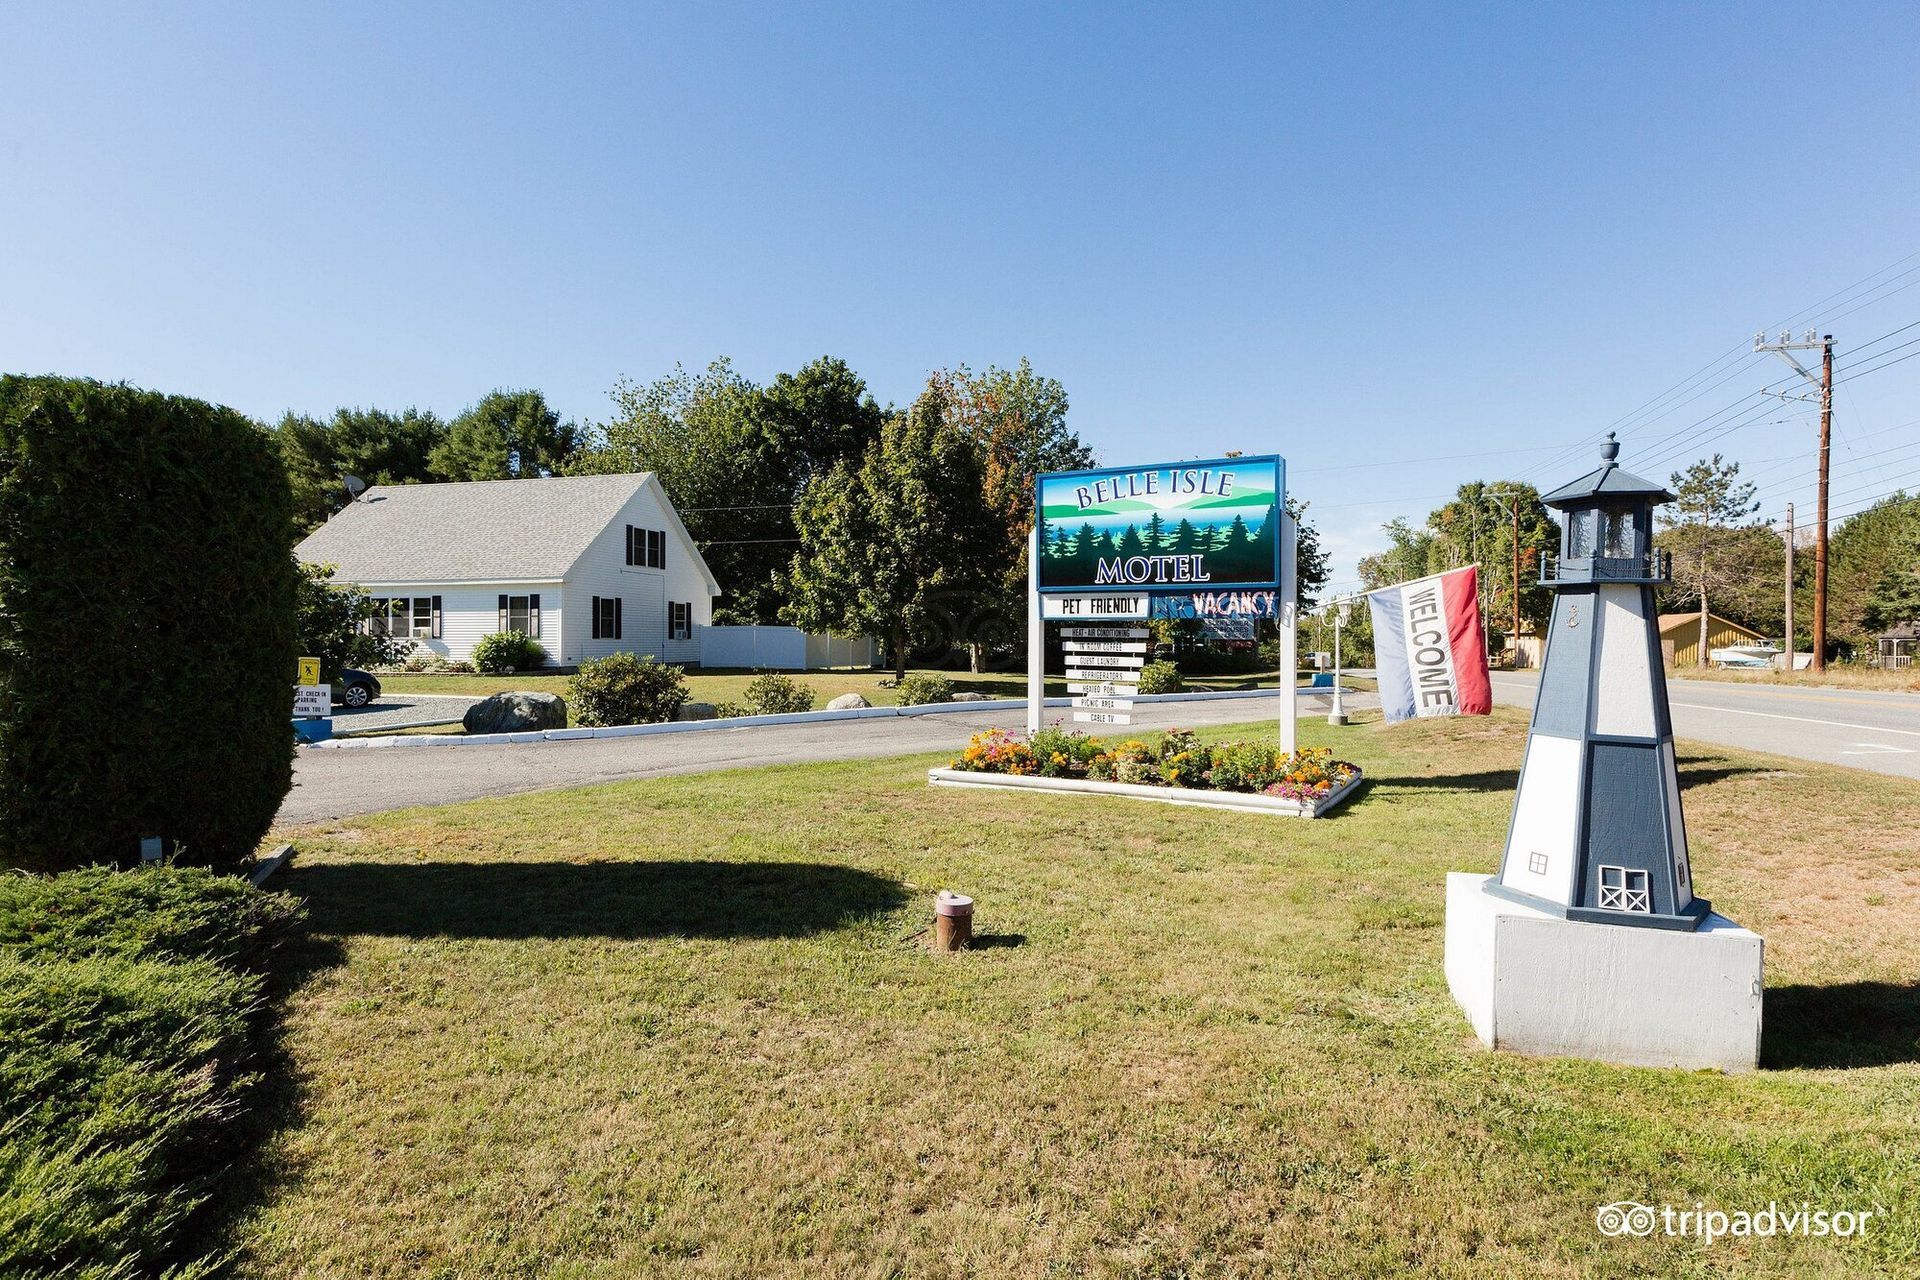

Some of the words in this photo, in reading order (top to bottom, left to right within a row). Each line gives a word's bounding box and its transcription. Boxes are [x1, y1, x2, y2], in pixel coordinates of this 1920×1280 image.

[1076, 471, 1159, 510] BELLE
[1170, 469, 1235, 497] ISLE
[1095, 554, 1210, 584] MOTEL
[1062, 598, 1082, 614] PET
[1090, 597, 1139, 614] FRIENDLY
[1193, 591, 1276, 615] VACANCY
[1096, 628, 1130, 637] CONDITIONING
[1102, 642, 1123, 651] COFFEE
[1409, 587, 1453, 708] WELCOME
[1079, 657, 1095, 665] GUEST
[1097, 658, 1120, 666] LAUNDRY
[1081, 671, 1123, 680] REFRIGERATORS
[1090, 714, 1105, 722] CABLE
